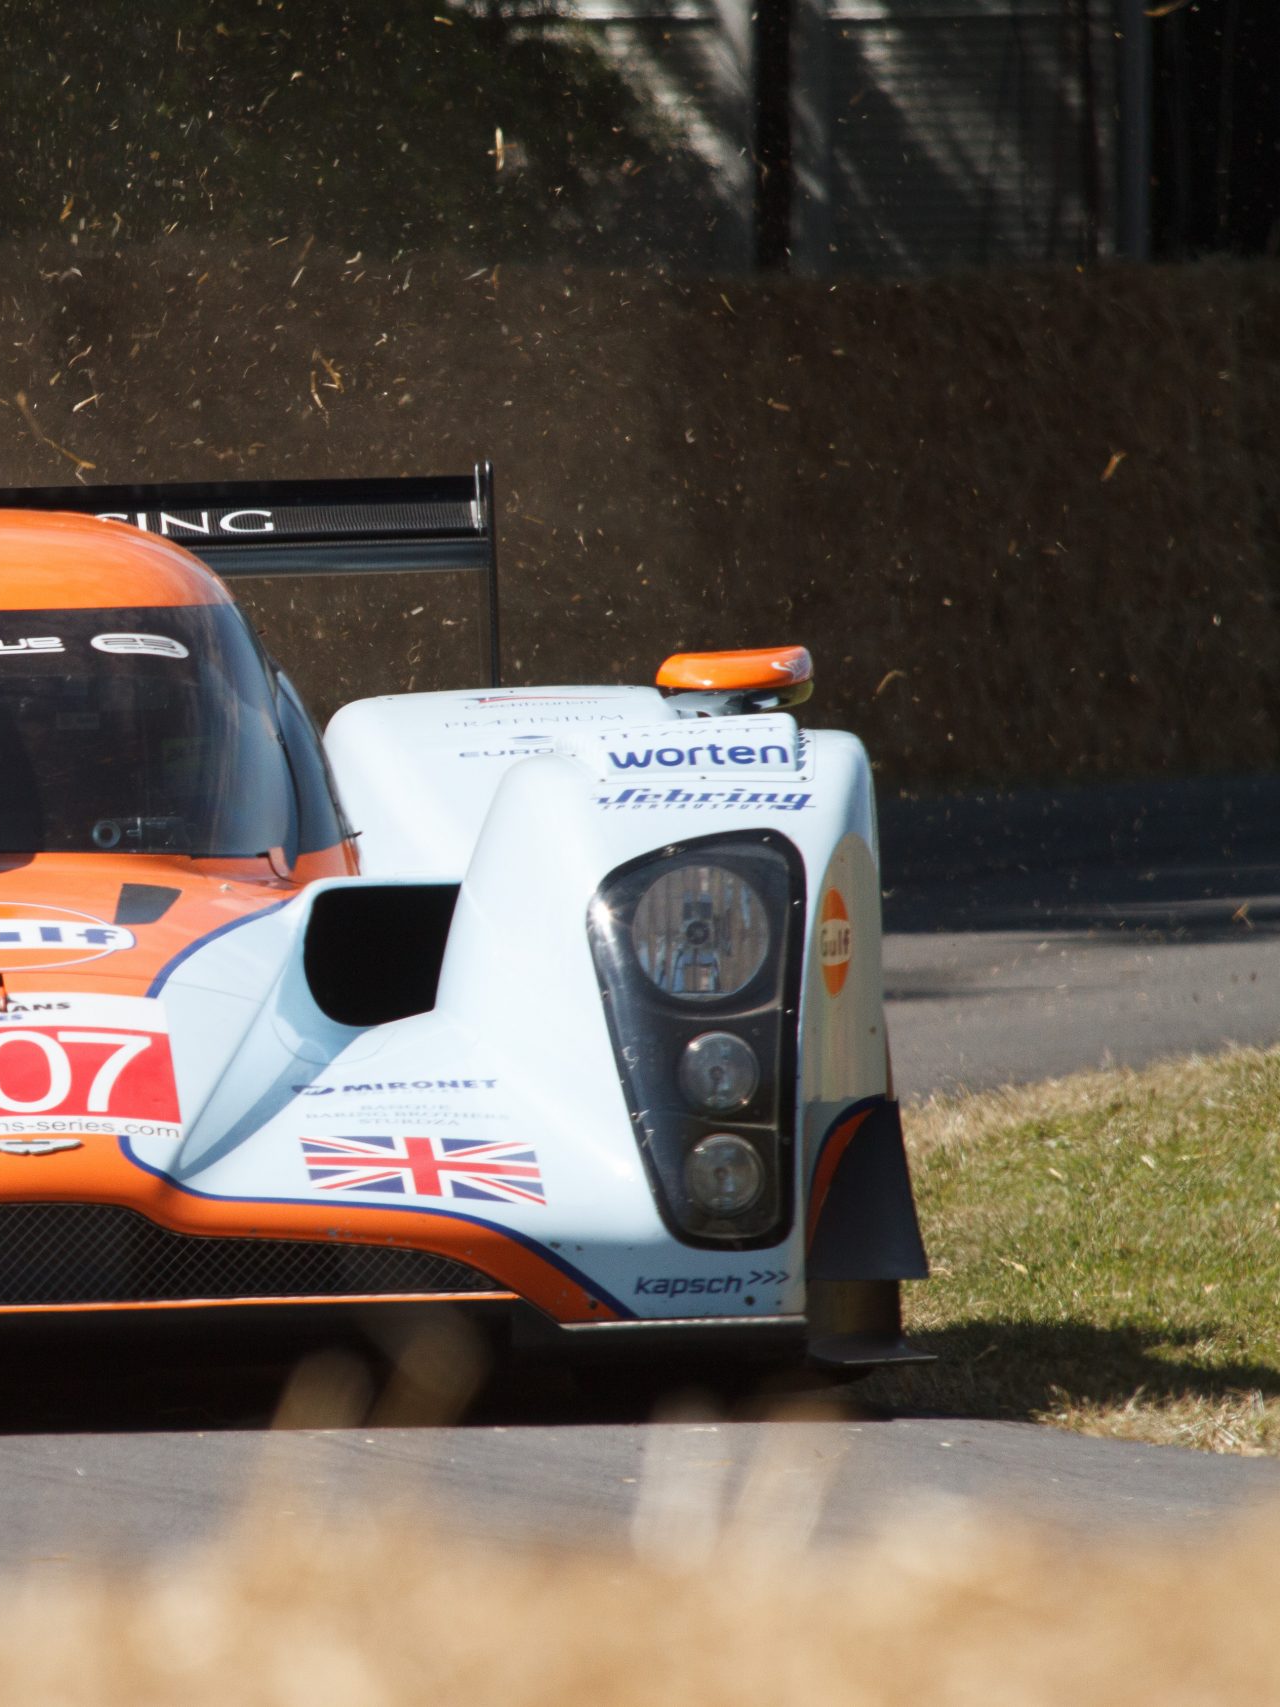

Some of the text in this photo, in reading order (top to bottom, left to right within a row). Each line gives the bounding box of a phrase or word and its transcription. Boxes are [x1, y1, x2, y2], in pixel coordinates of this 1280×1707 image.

[609, 743, 789, 769] worten
[595, 788, 815, 811] Sebring
[342, 1079, 498, 1093] MIRONET
[634, 1275, 743, 1298] kapsch
